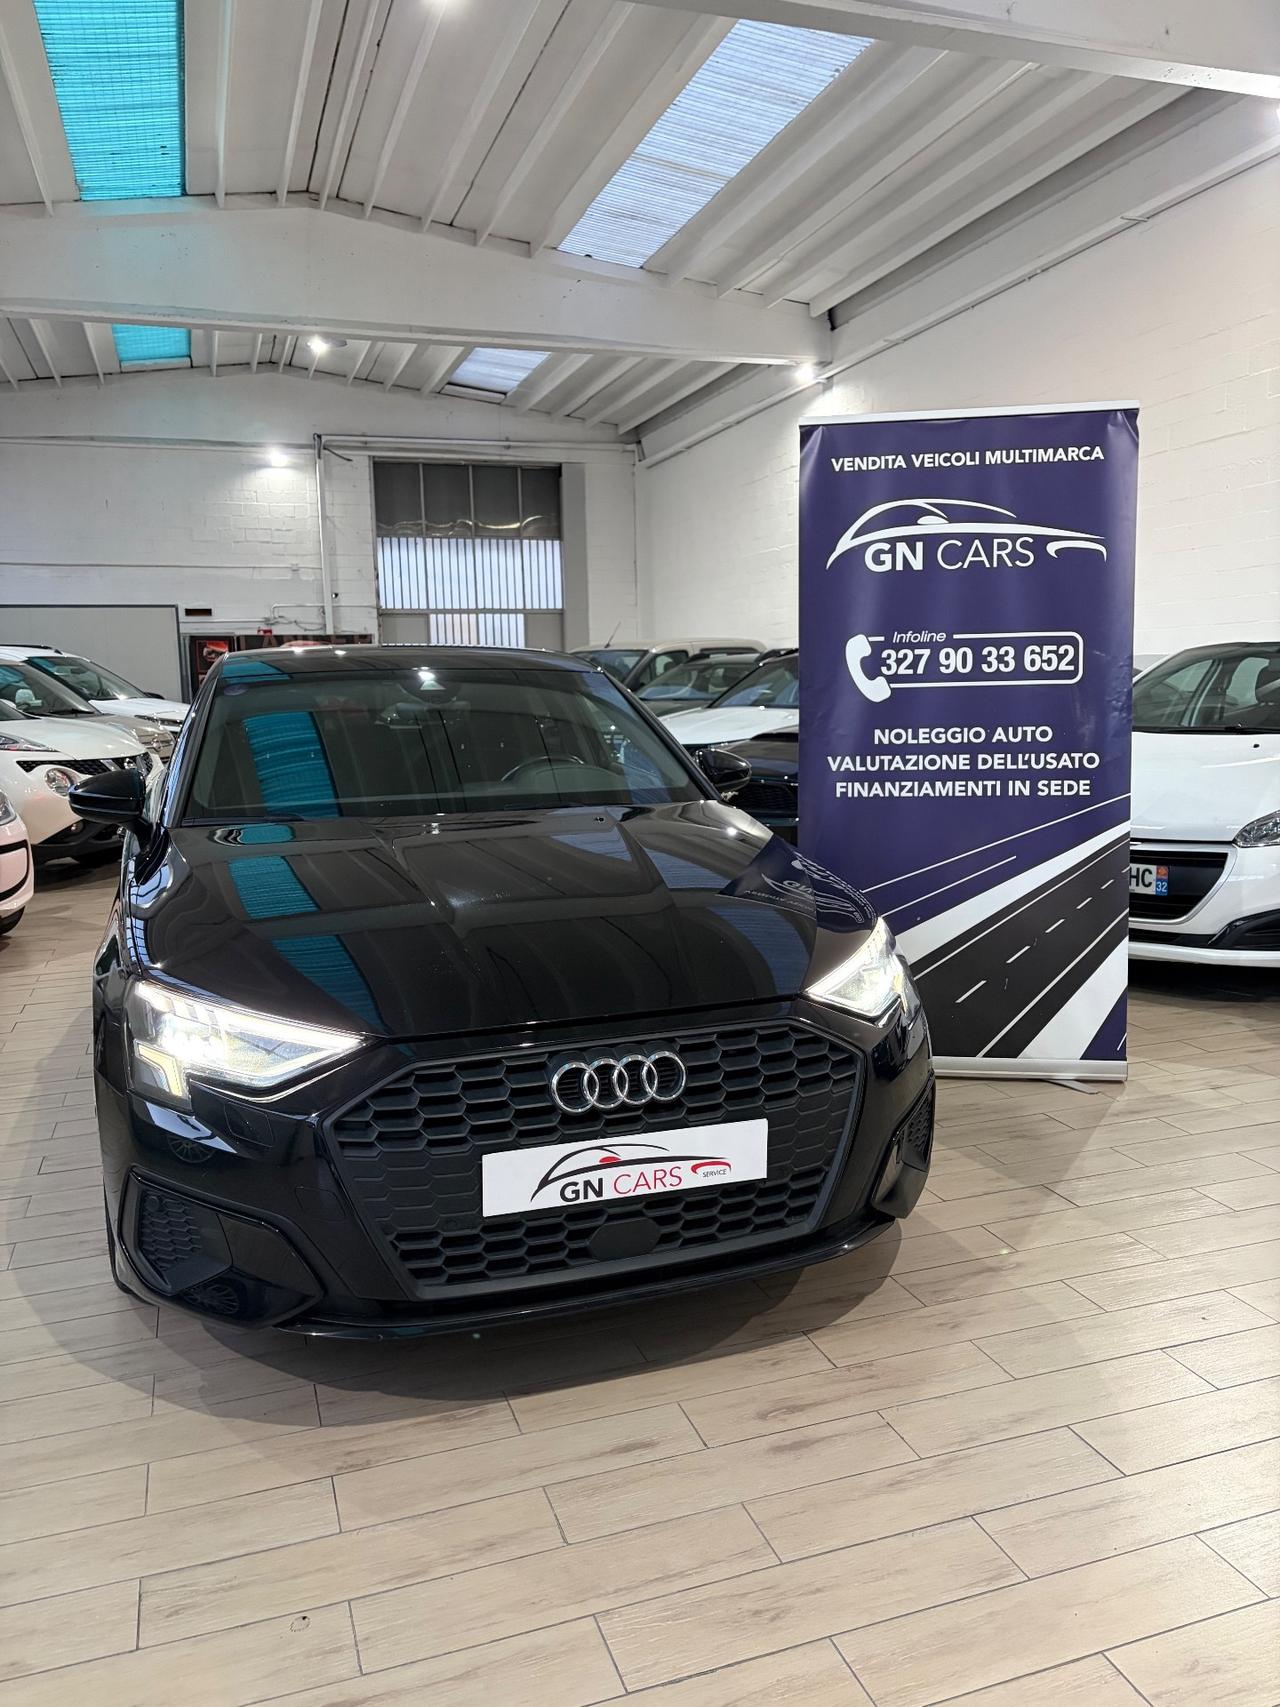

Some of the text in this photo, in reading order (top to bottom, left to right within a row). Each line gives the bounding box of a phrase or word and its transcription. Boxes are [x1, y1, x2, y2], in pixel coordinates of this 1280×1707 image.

[831, 445, 1105, 472] VENDITA VEICOLI MULTIMARCA
[864, 537, 1035, 573] GN CARS
[892, 630, 947, 644] Infoline
[881, 644, 1075, 676] 327 90 33 652
[874, 726, 1053, 745] NOLEGGIO AUTO
[827, 753, 1100, 772] VALUTAZIONE DELL'USATO
[836, 779, 1091, 798] FINANZIAMENTI IN SEDE
[1157, 882, 1167, 892] 32
[702, 1169, 727, 1177] SERVICE
[559, 1166, 683, 1203] GN CARS
